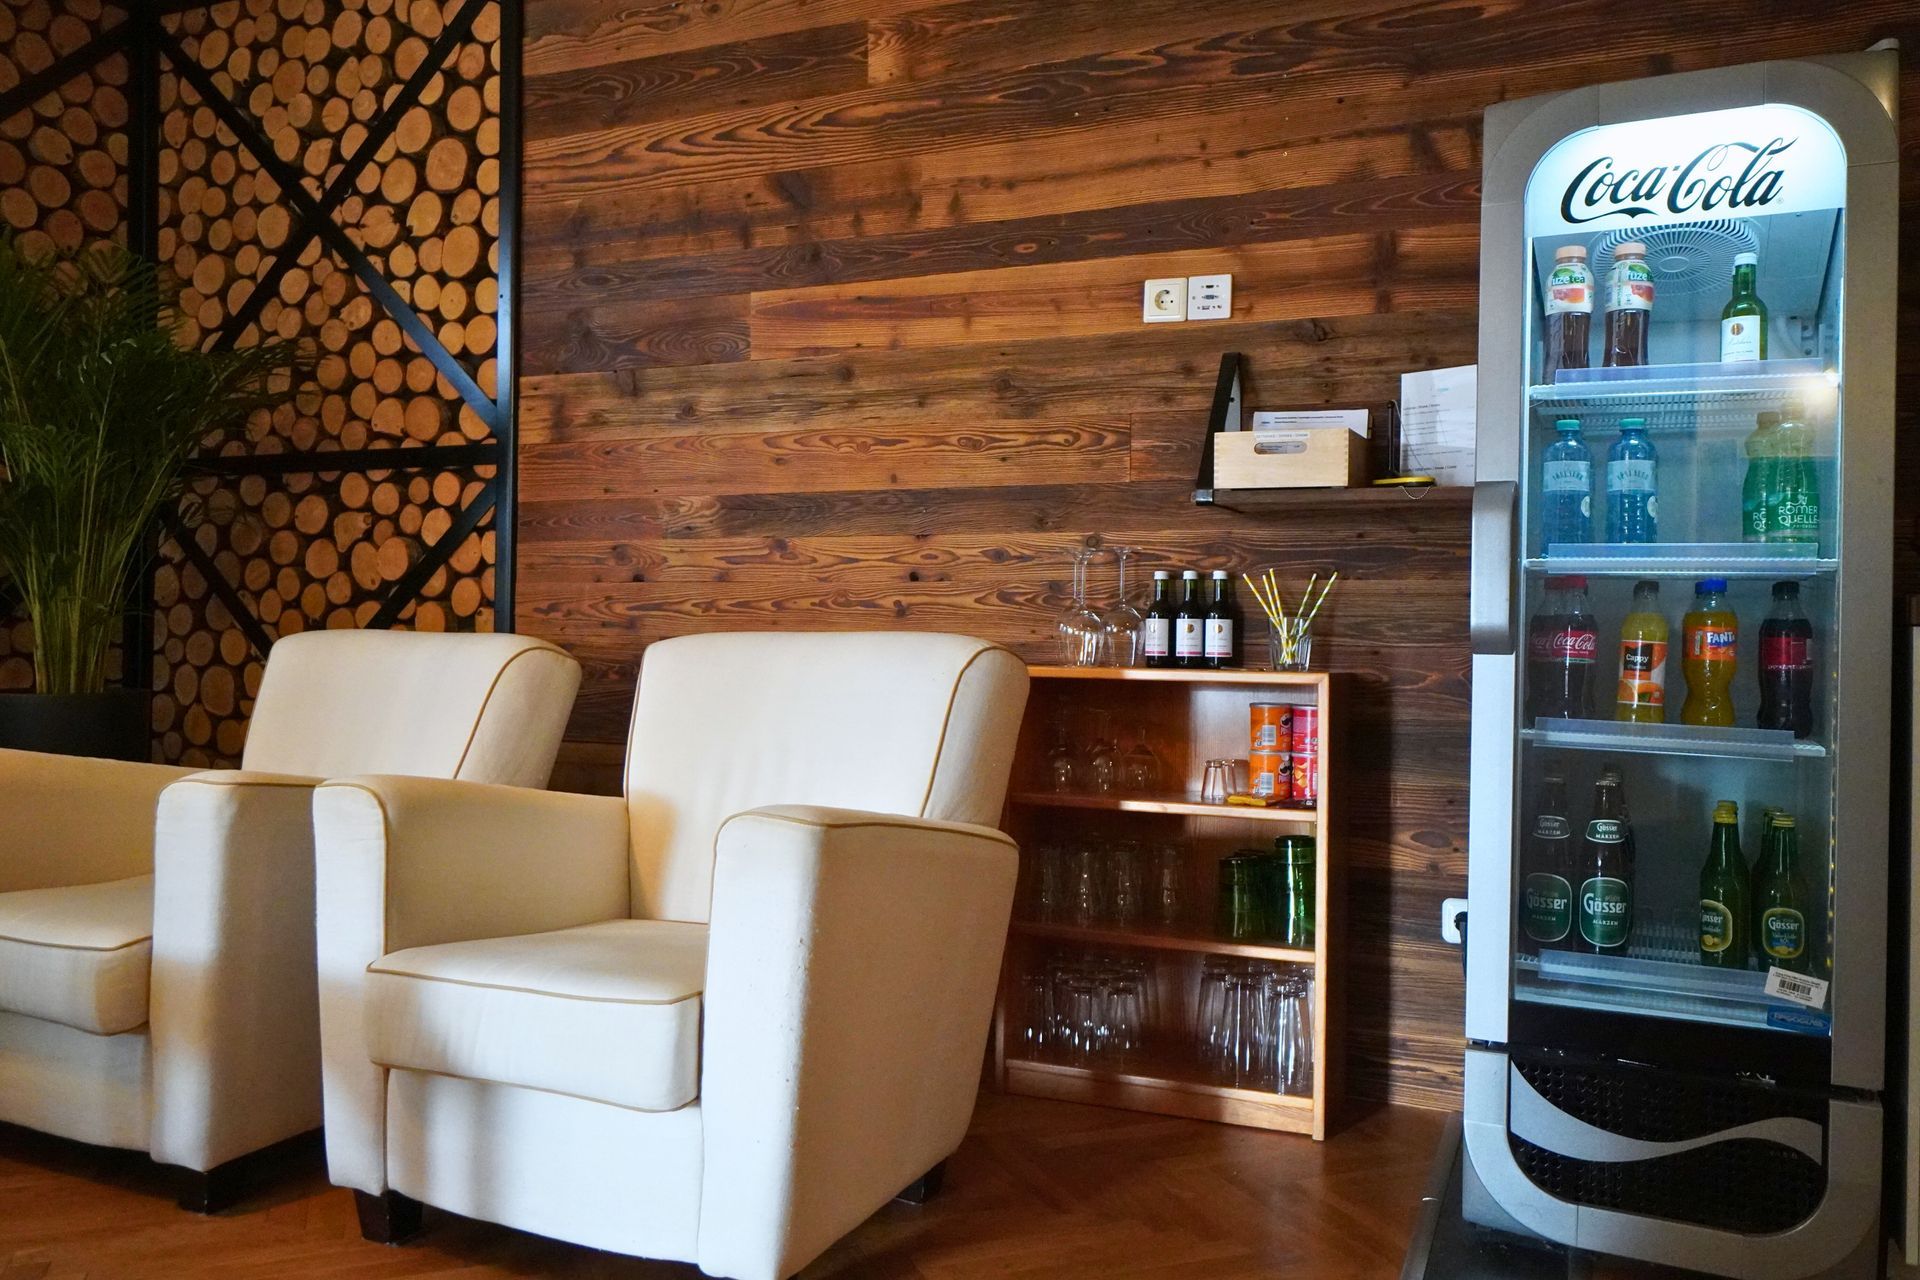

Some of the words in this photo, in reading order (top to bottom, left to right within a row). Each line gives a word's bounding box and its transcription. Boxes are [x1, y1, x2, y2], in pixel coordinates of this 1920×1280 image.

[1561, 136, 1799, 224] Coca-Cola
[1626, 653, 1649, 663] Cappy
[1583, 892, 1627, 915] Gösser
